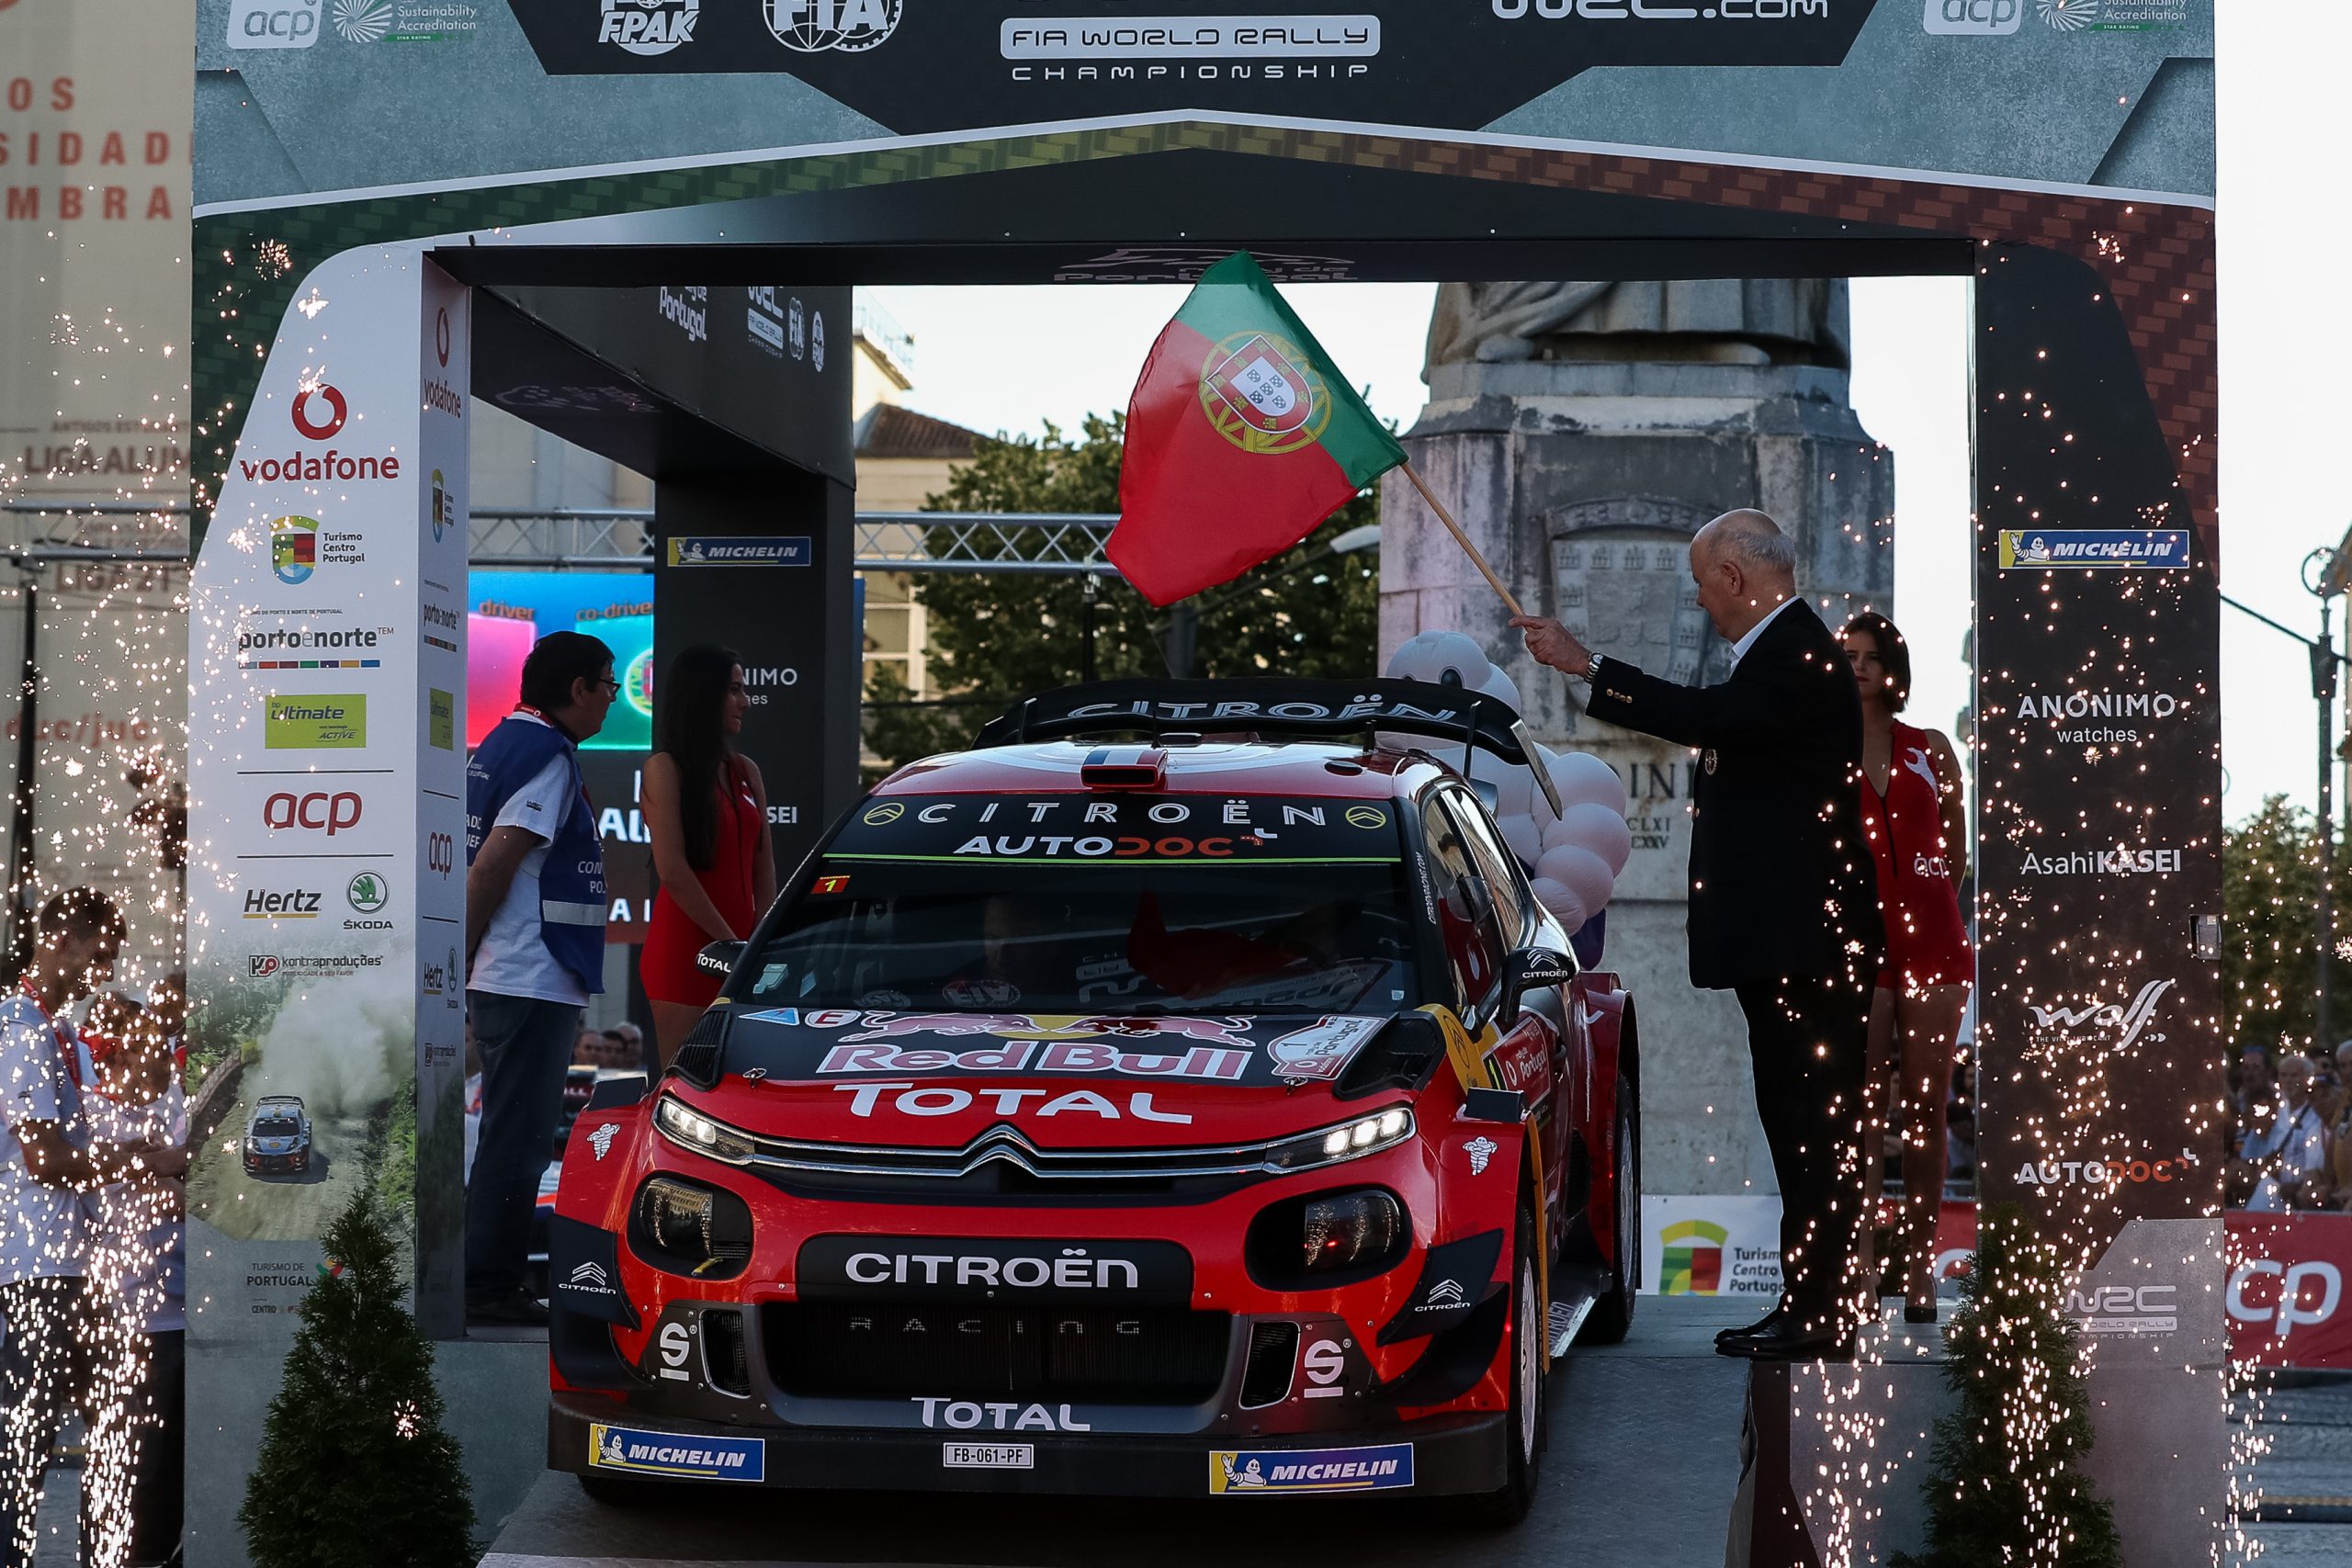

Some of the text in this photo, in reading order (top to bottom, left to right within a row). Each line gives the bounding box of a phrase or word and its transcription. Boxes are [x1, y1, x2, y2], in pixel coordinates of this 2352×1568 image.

[397, 4, 477, 18] Sustainability
[774, 0, 888, 31] FIA
[1941, 0, 2016, 28] acp
[2104, 6, 2187, 20] Accreditation
[244, 10, 314, 41] acp
[397, 18, 477, 31] Accreditation
[598, 10, 700, 44] FPAK
[1012, 28, 1368, 47] FIA WORLD RALLY
[1012, 64, 1368, 80] CHAMPIONSHIP
[424, 377, 461, 419] vodafone
[240, 450, 400, 482] vodafone
[323, 532, 362, 542] Turismo
[323, 543, 356, 553] Centro
[708, 547, 798, 558] MICHELIN
[2053, 543, 2172, 557] MICHELIN
[323, 553, 366, 565] Portugal
[479, 600, 535, 621] driver
[271, 705, 345, 720] ultimate
[1068, 694, 1458, 723] CITROËN
[2018, 694, 2176, 719] ANONIMO
[2057, 727, 2137, 743] watches
[264, 791, 362, 837] acp
[919, 799, 1326, 827] CITROËN
[429, 831, 453, 880] acp
[954, 836, 1235, 857] AUTODOC
[825, 879, 837, 892] 1
[243, 888, 321, 913] Hertz
[343, 919, 394, 930] ŠKODA
[282, 954, 382, 968] kontraproduções
[697, 953, 732, 974] TOTAL
[424, 963, 443, 989] Hertz
[1522, 969, 1568, 979] CITROËN
[816, 1041, 1253, 1080] Red Bull
[832, 1082, 1193, 1123] TOTAL
[2018, 1160, 2173, 1185] AUTODOC
[252, 1263, 291, 1271] TURISMO
[844, 1247, 1138, 1288] CITROËN
[1733, 1263, 1778, 1277] Centro
[246, 1276, 311, 1286] PORTUGAL
[559, 1283, 616, 1296] CITROËN
[1414, 1300, 1471, 1313] CITROËN
[849, 1315, 1140, 1336] RACING
[2084, 1320, 2174, 1329] ORLD RALLY
[910, 1397, 1091, 1431] TOTAL
[628, 1444, 746, 1468] MICHELIN
[953, 1447, 1023, 1464] FB-061-PF
[1271, 1459, 1398, 1482] MICHELIN
